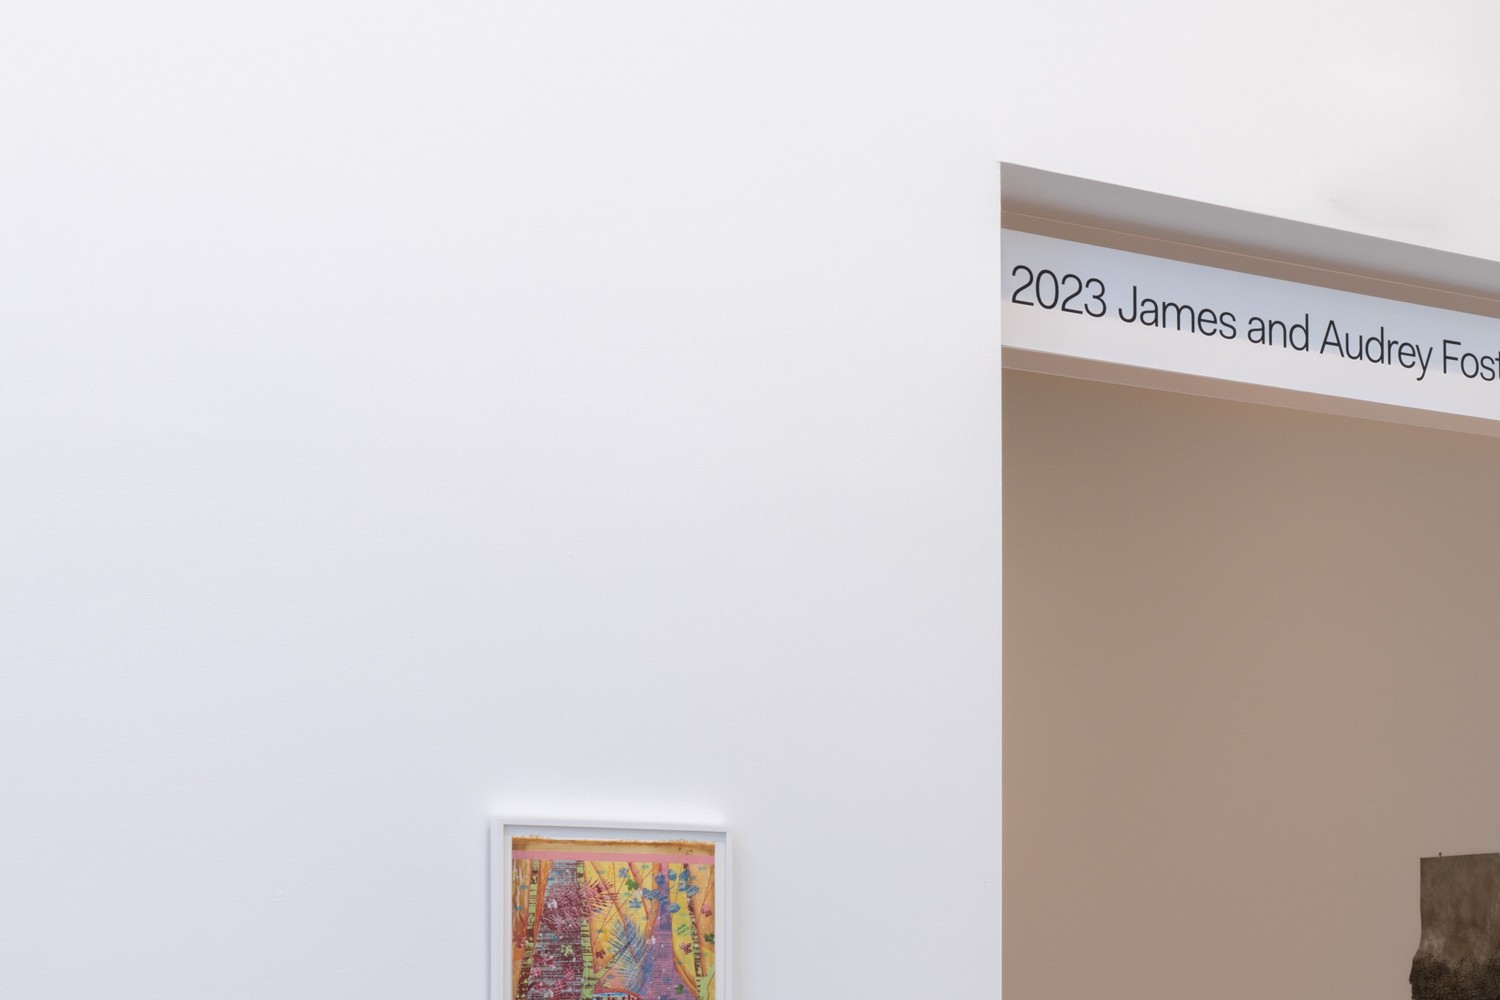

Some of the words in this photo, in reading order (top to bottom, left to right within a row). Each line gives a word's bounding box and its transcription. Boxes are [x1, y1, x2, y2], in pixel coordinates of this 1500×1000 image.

[1011, 265, 1107, 318] 2023
[1118, 285, 1237, 340] James
[1247, 313, 1309, 352] and
[1319, 320, 1433, 381] Audrey
